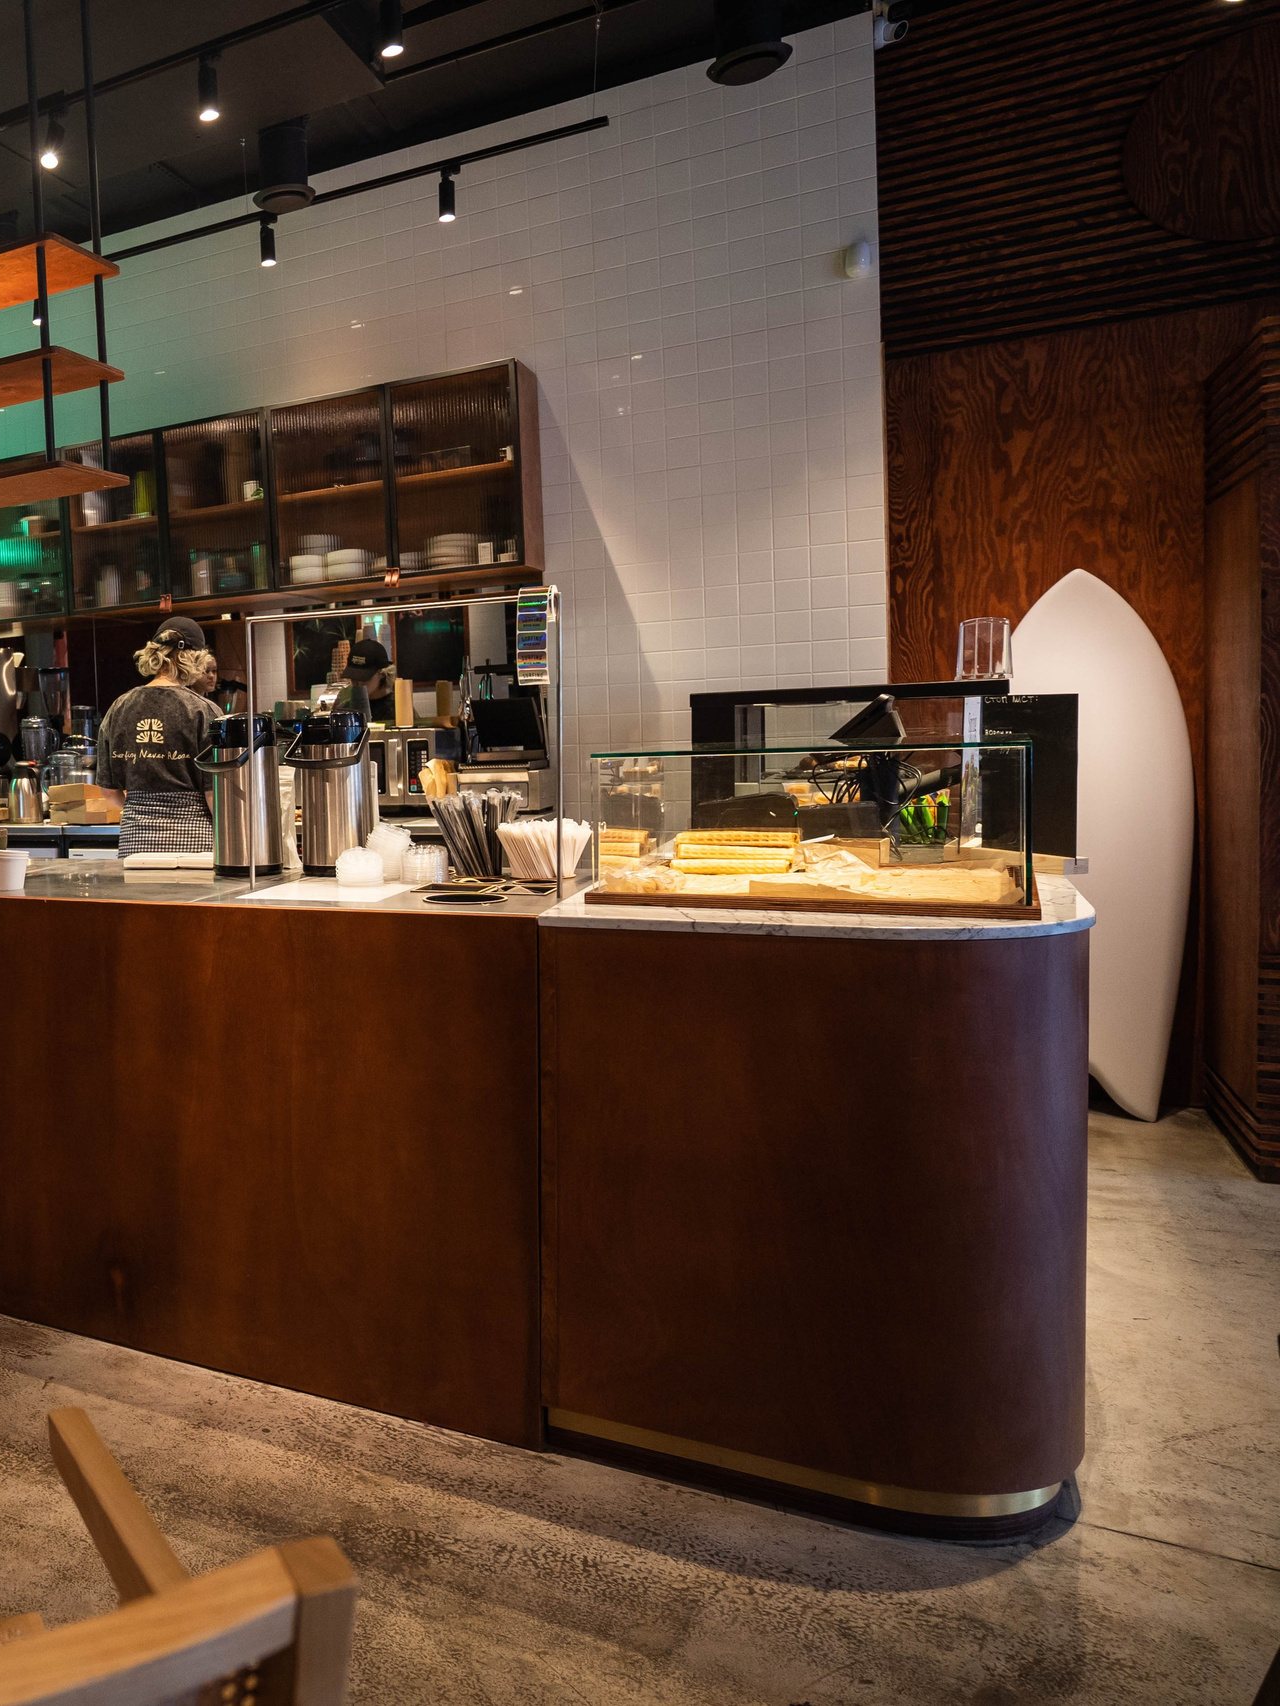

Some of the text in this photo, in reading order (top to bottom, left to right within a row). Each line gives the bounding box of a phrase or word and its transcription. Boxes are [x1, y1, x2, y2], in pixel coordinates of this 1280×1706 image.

[111, 749, 191, 765] Surfing Never Alone
